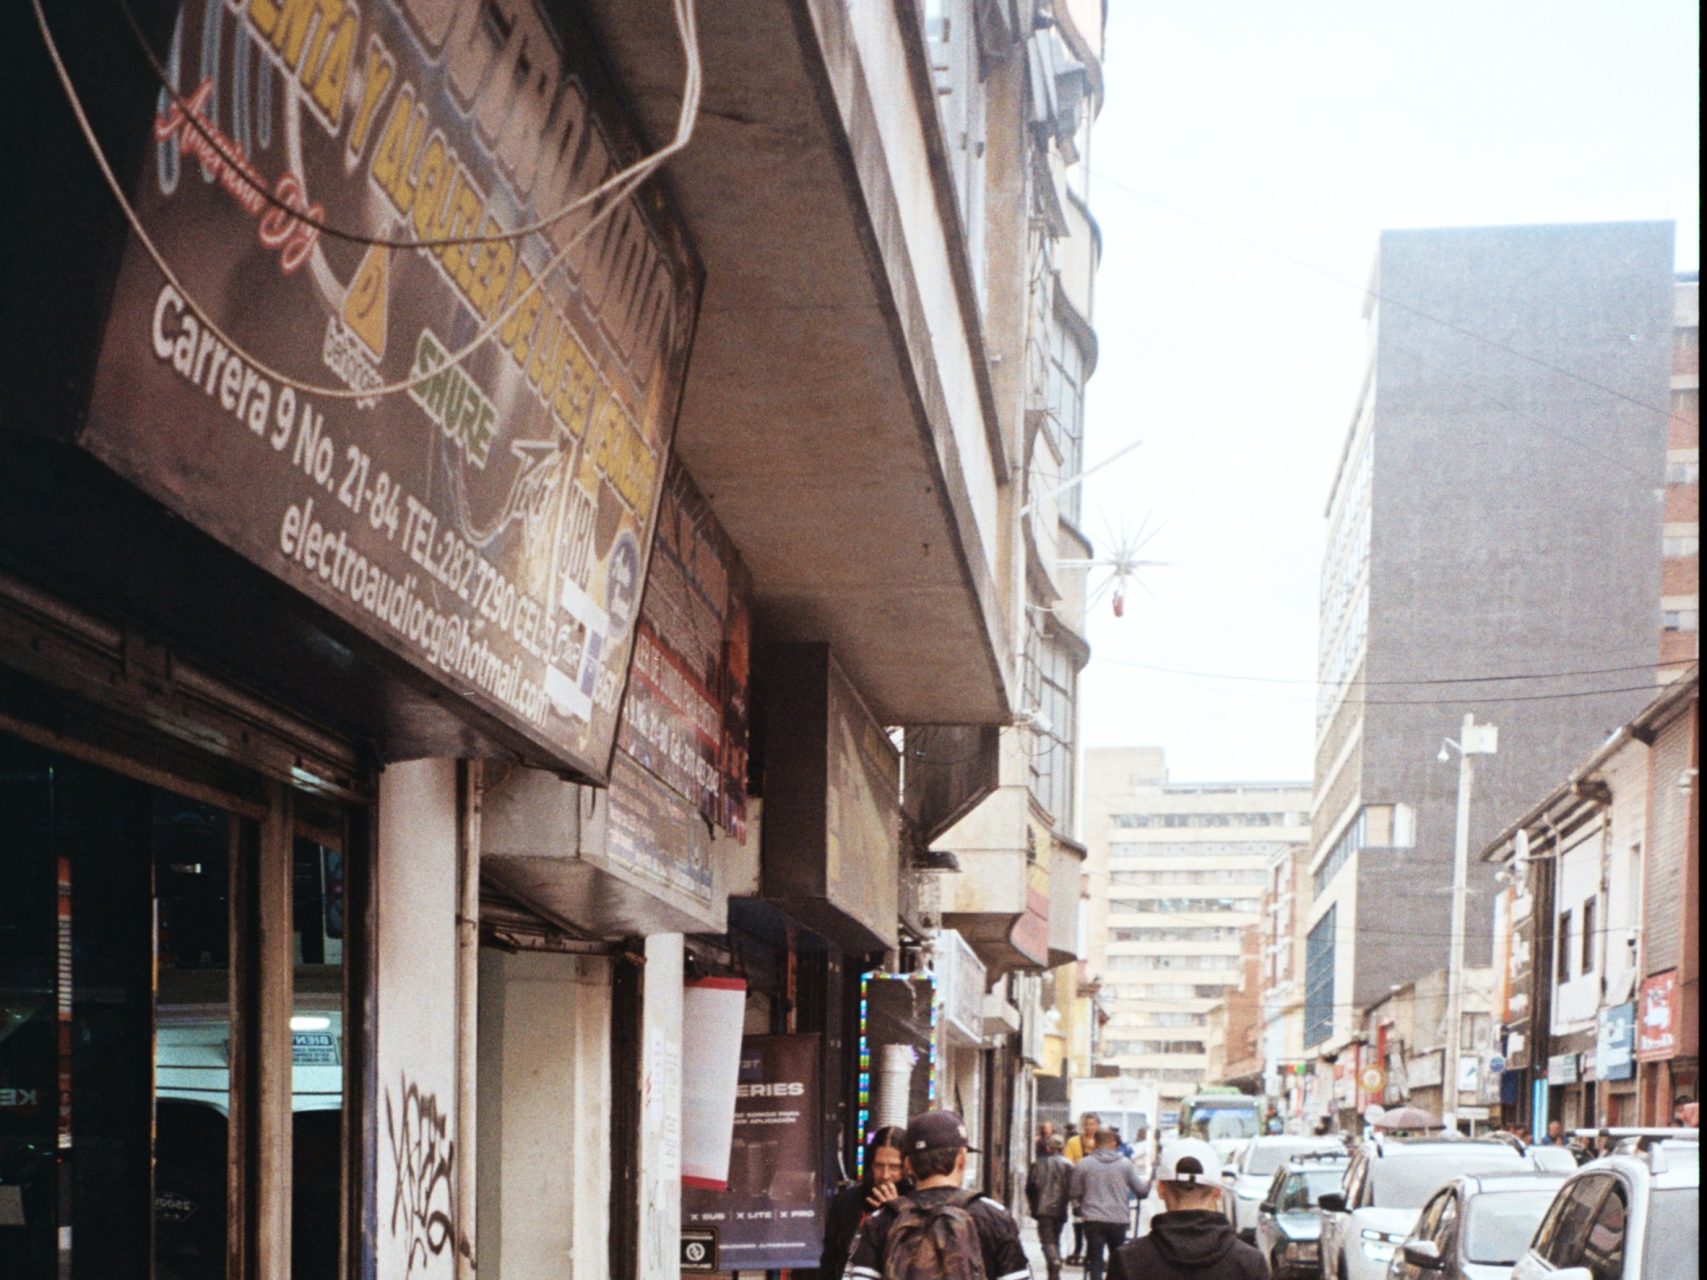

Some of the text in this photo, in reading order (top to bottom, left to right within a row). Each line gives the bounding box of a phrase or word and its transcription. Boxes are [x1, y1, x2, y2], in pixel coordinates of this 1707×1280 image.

[350, 42, 394, 158] Y
[371, 86, 515, 320] ALQUILER
[153, 284, 271, 436] Carrera
[270, 388, 296, 451] 9
[293, 403, 334, 493] No.
[338, 444, 401, 540] 21-84
[408, 330, 498, 466] SHURE
[281, 497, 550, 728] electroaudiocg@hotmail.com
[736, 1082, 805, 1098] ERIES
[690, 1213, 699, 1221] X
[736, 1211, 745, 1219] X
[780, 1209, 815, 1218] X PRO
